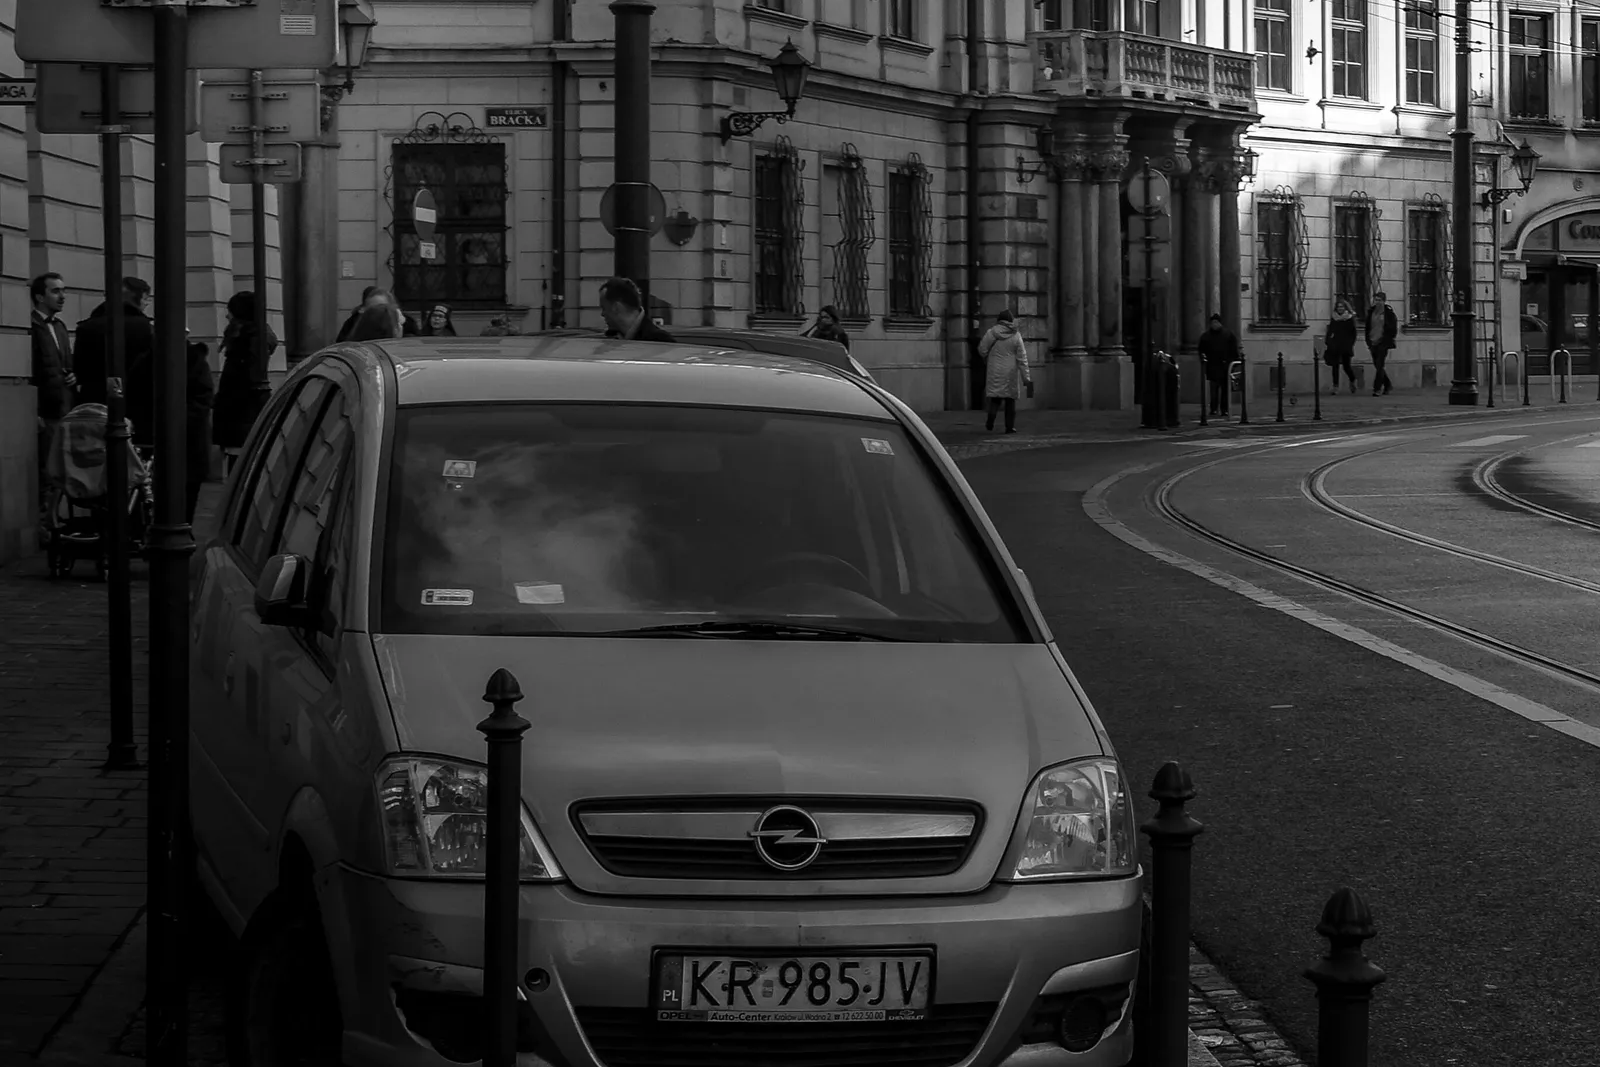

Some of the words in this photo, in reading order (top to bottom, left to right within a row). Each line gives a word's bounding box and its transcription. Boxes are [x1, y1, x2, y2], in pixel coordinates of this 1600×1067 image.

[0, 85, 27, 98] AGA
[490, 115, 542, 125] BRACKA
[689, 961, 758, 1006] KR
[662, 989, 679, 1002] PL
[660, 1011, 691, 1020] OPEL
[710, 1012, 771, 1022] Auto-Center
